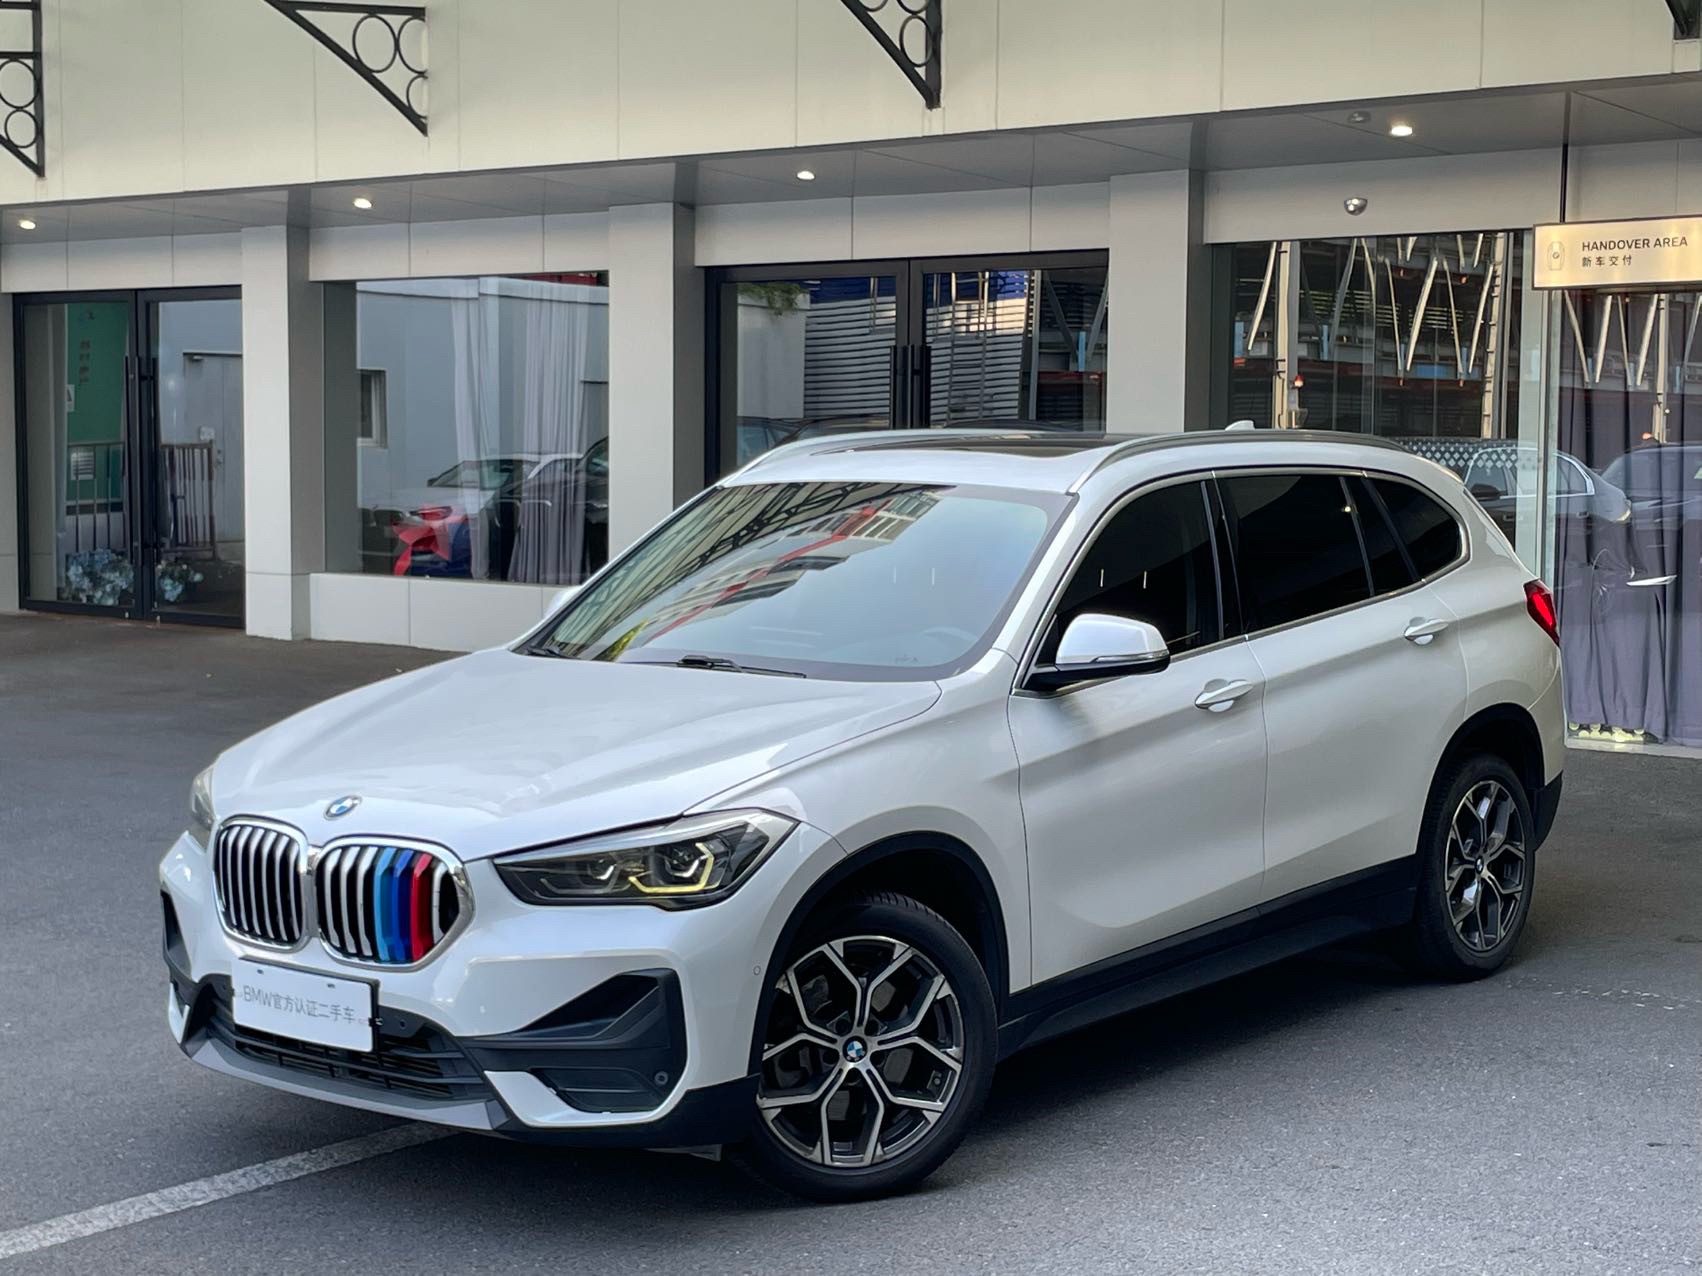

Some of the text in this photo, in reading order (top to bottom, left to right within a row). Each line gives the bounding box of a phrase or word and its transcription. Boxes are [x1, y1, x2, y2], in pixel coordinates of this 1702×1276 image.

[1582, 236, 1688, 251] HANDOVER AREA
[1582, 254, 1632, 267] 新车交付
